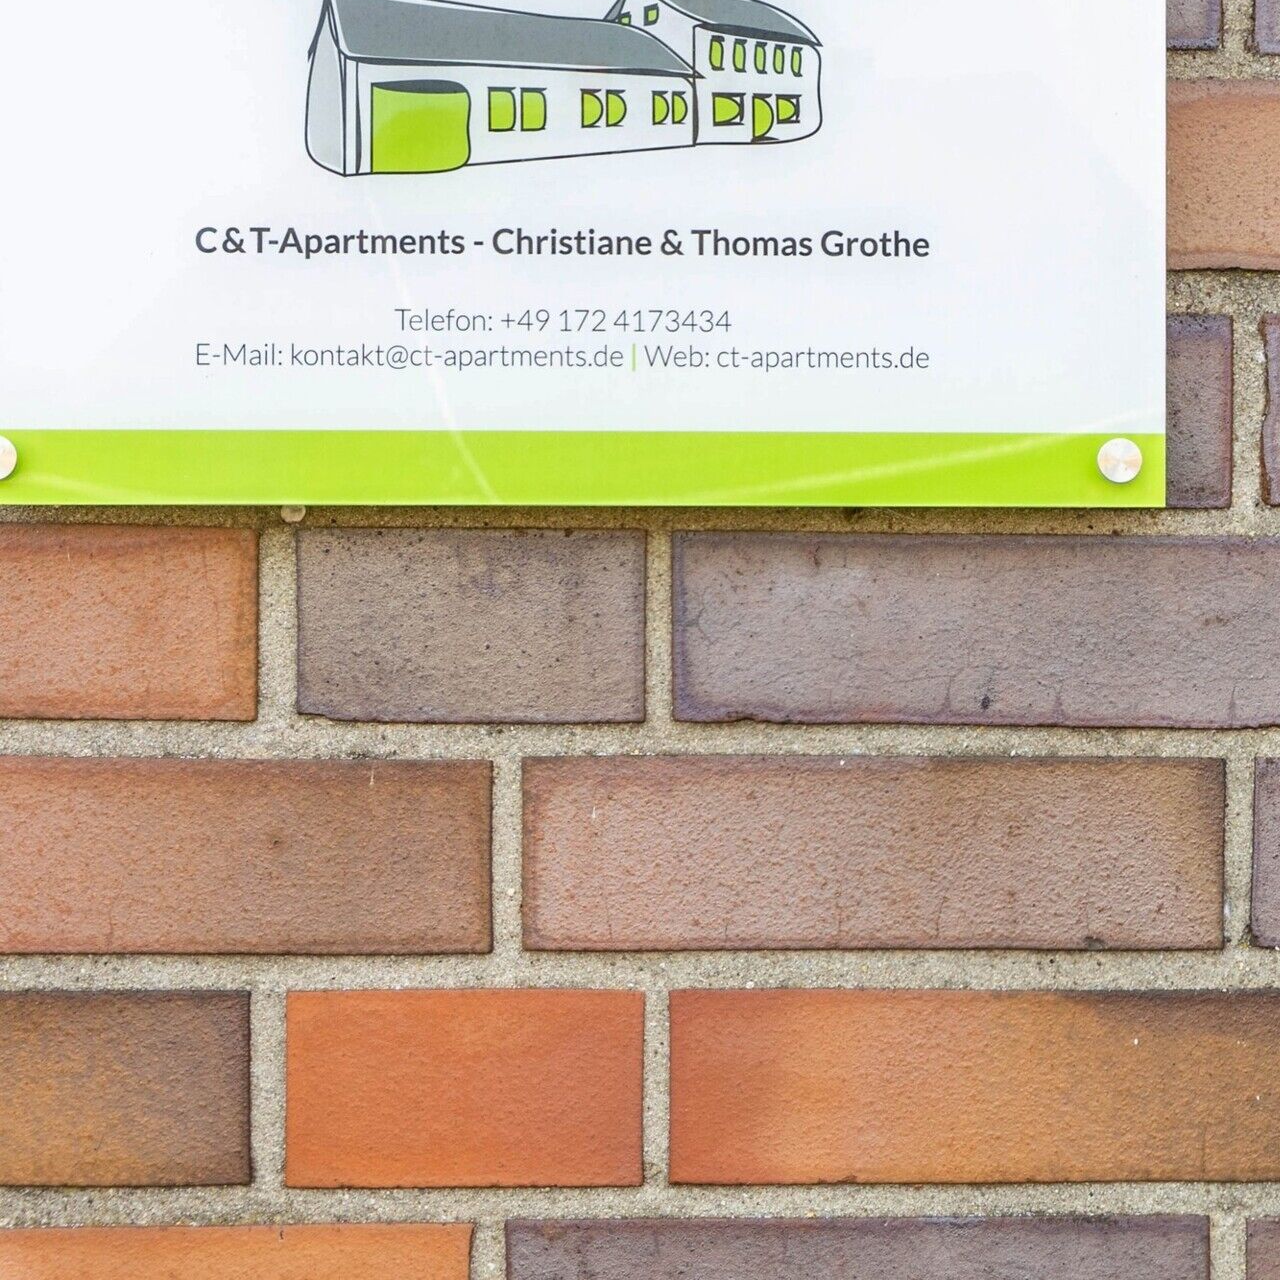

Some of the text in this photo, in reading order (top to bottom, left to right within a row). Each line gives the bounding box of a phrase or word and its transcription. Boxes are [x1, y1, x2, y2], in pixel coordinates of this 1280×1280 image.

[491, 227, 653, 257] Christiane
[659, 228, 686, 257] &
[690, 228, 814, 258] Thomas
[820, 229, 931, 259] Grothe
[394, 307, 733, 334] Telefon: +49 172 4173434
[195, 342, 284, 368] E-Mail:
[290, 341, 625, 372] kontakt@ct-apartments.de
[642, 343, 711, 369] Web:
[715, 344, 931, 373] ct-apartments.de
